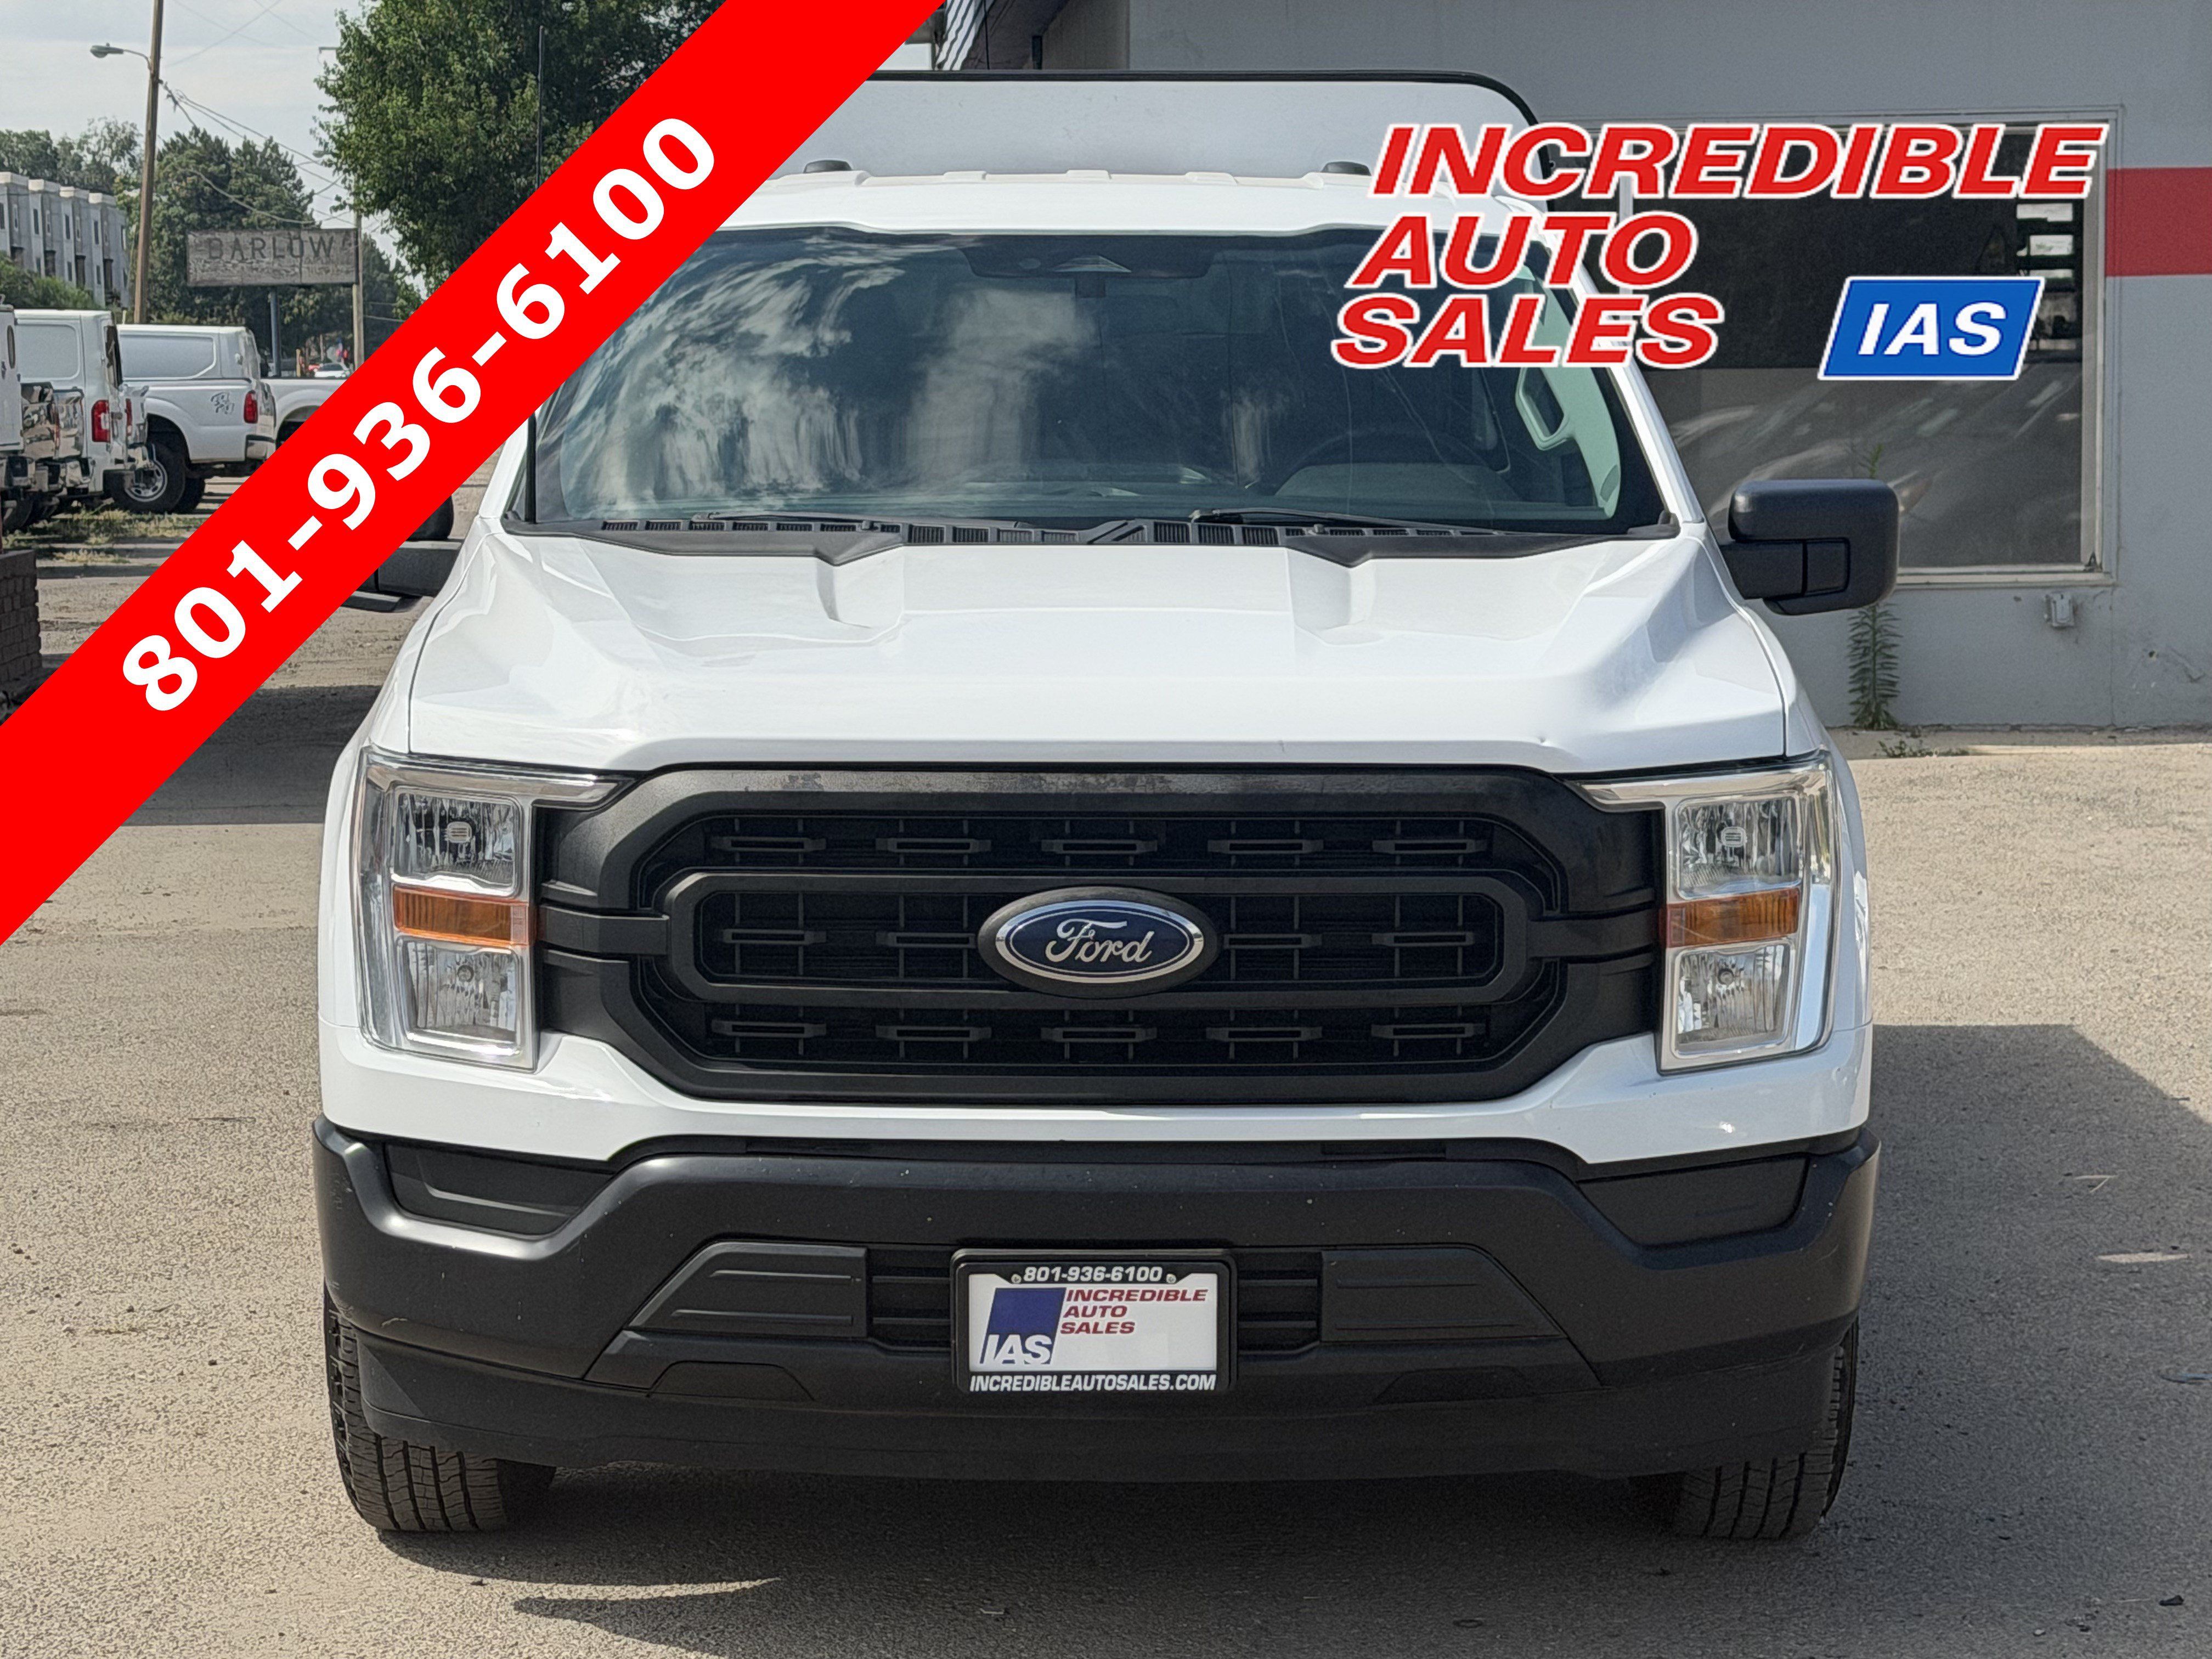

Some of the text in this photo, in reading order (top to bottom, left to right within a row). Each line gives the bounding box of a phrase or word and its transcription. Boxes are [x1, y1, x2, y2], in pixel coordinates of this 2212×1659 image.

[1045, 918, 1154, 962] Ford
[1024, 1266, 1162, 1282] 801-936-6100
[1067, 1289, 1208, 1301] INCREDIBLE
[1063, 1306, 1127, 1318] AUTO
[1060, 1322, 1135, 1334] SALES
[988, 1334, 1052, 1365] IAS
[969, 1374, 1217, 1392] INCREDIBLEAUTOSALES.COM
